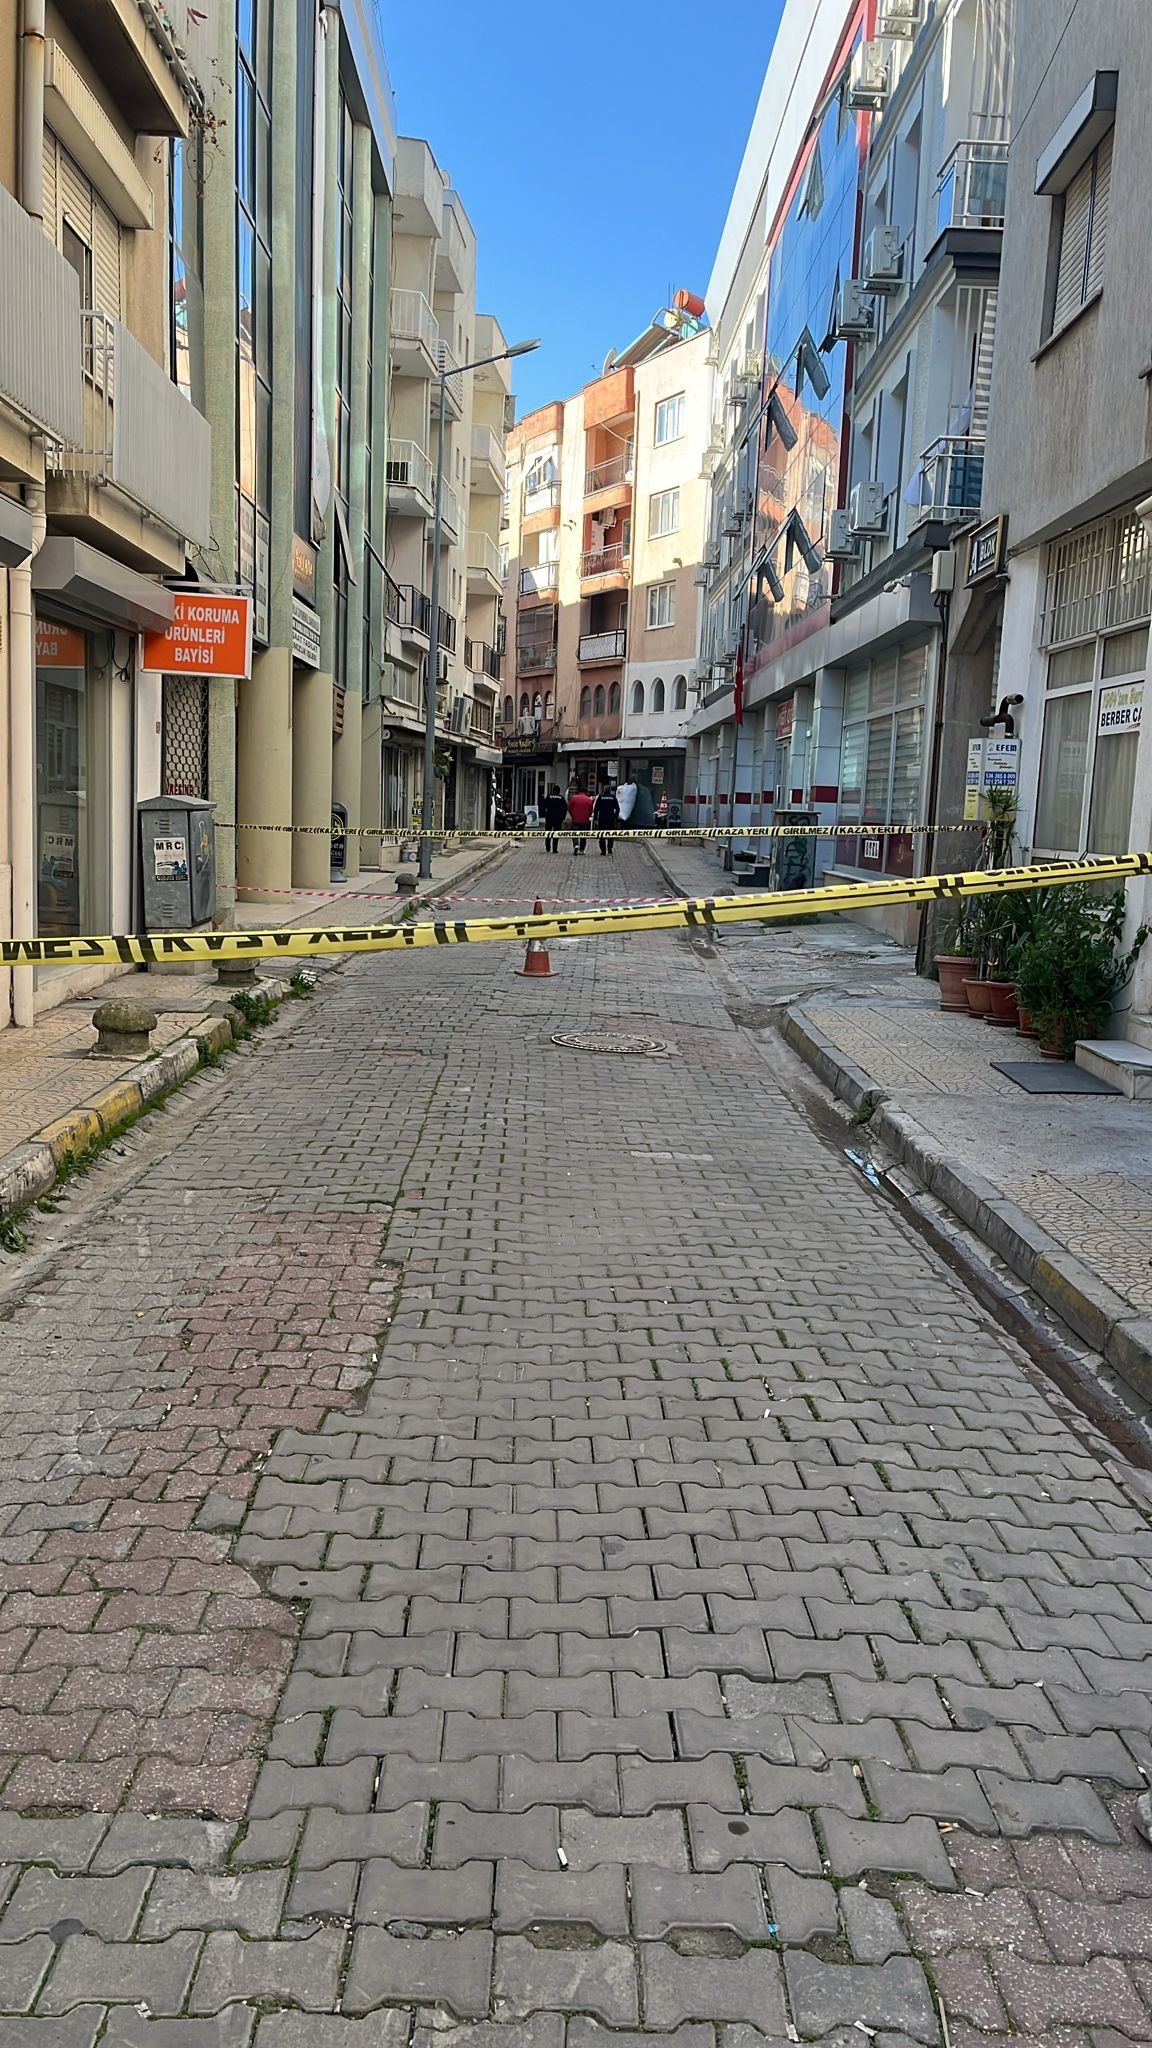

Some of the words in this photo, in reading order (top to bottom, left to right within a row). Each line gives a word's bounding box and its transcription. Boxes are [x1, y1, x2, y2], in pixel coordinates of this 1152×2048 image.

[969, 541, 978, 576] A
[980, 536, 997, 562] BLOK
[188, 606, 240, 624] KORUMA
[175, 646, 214, 664] BAYİSİ
[1101, 709, 1131, 727] BERBER
[996, 744, 1017, 752] EFEM
